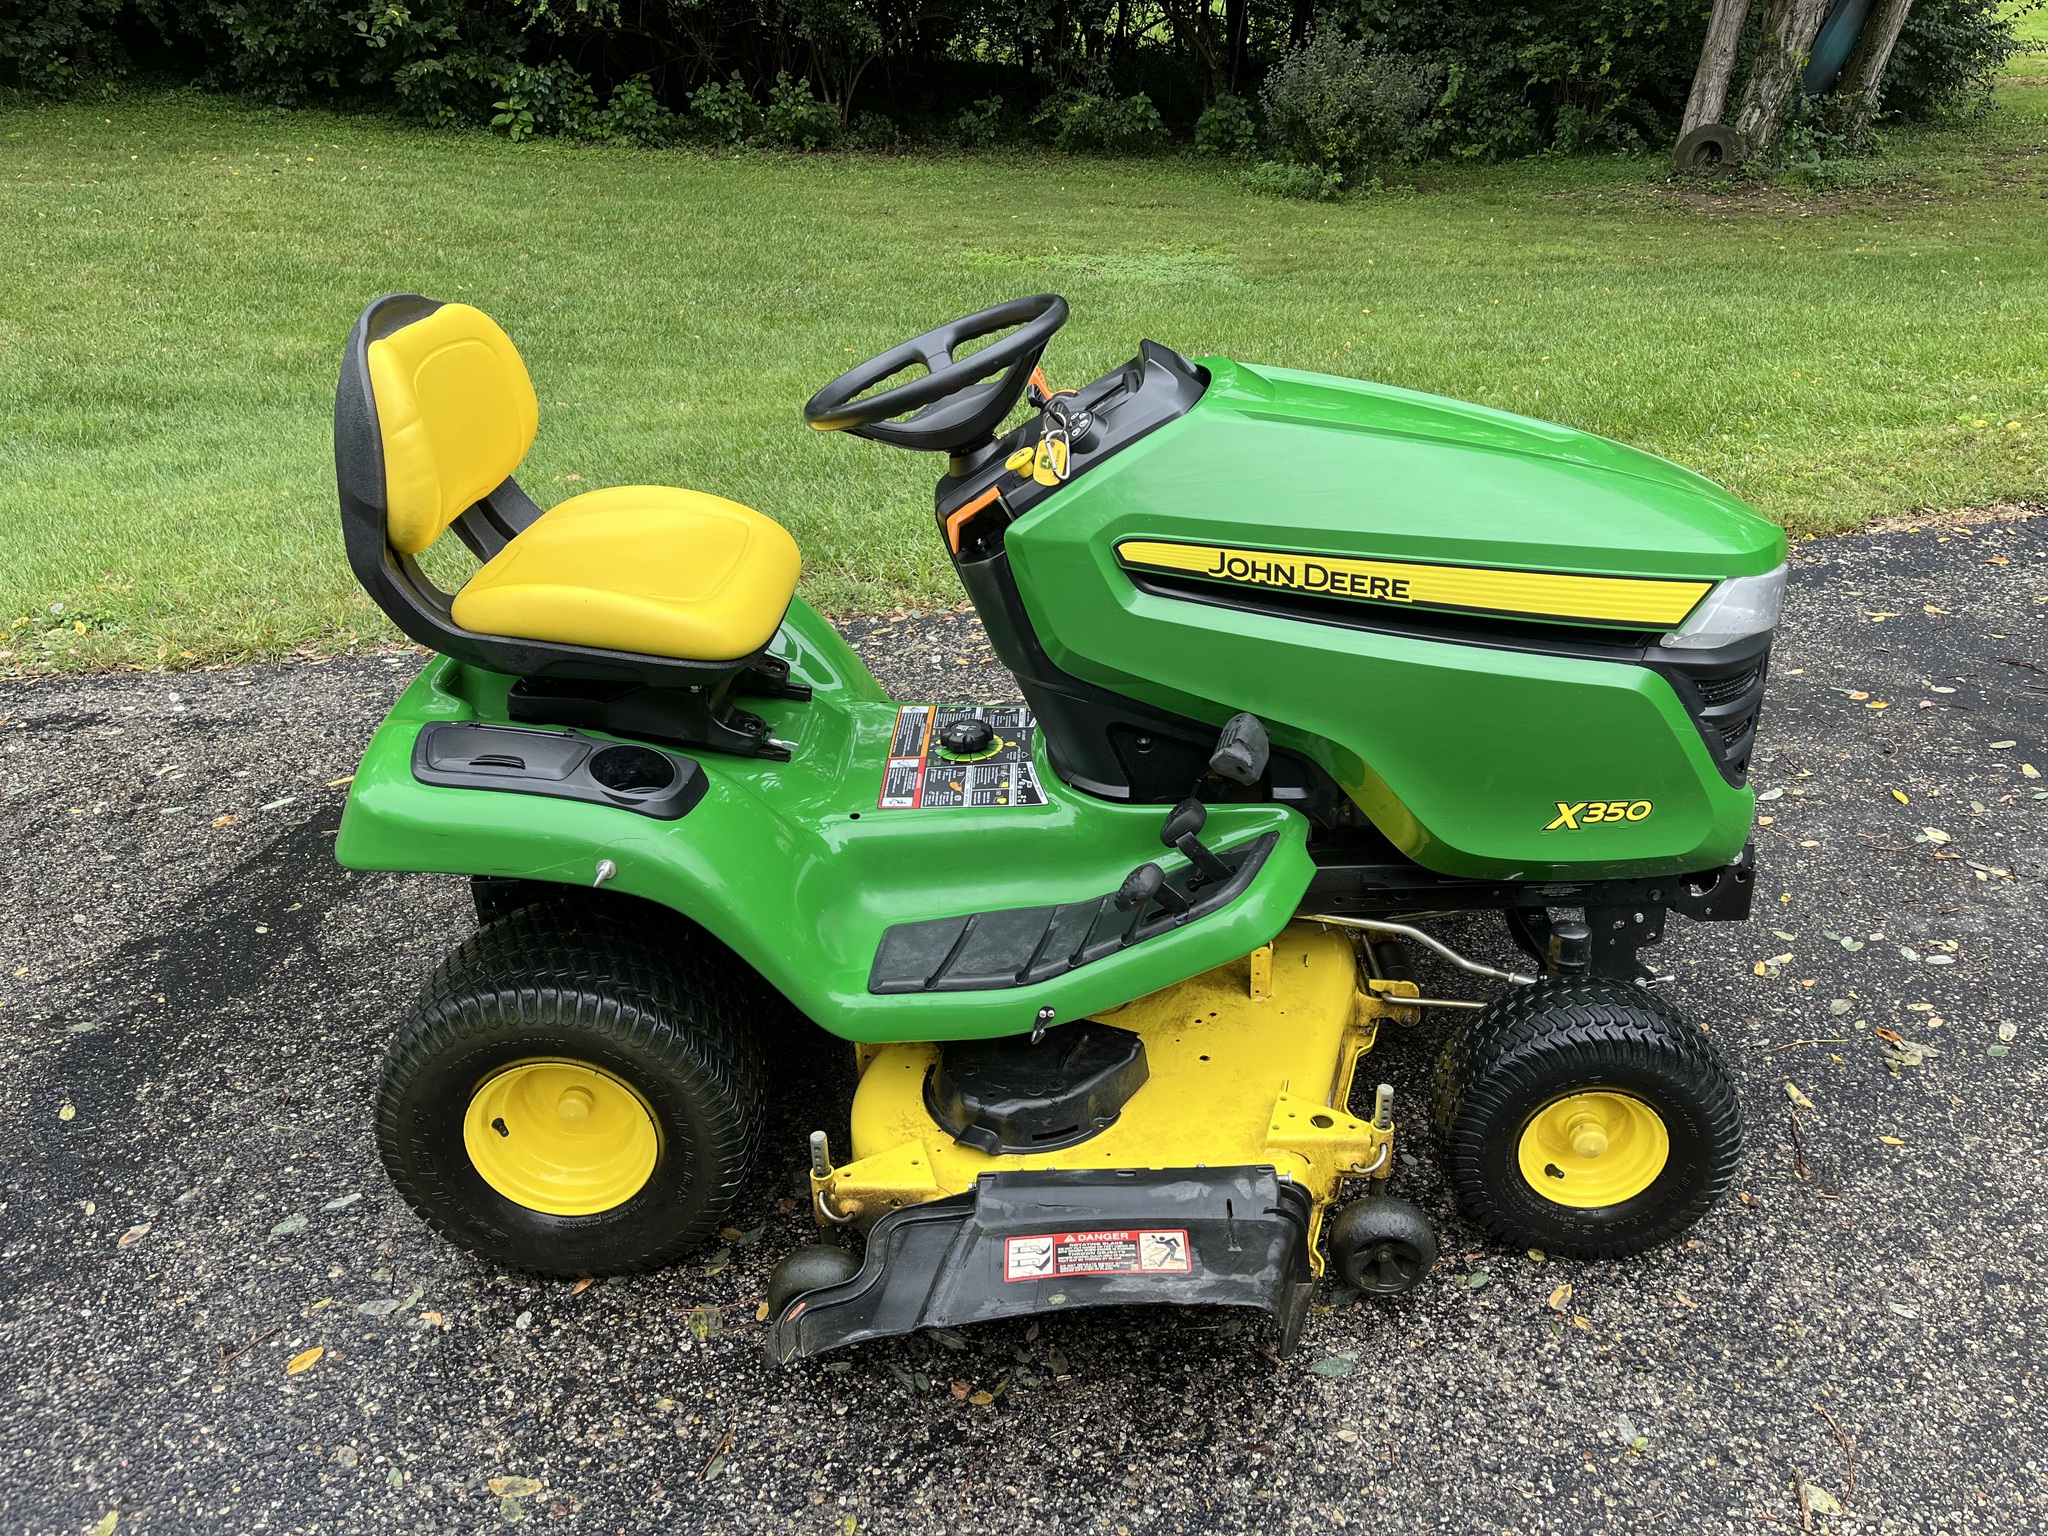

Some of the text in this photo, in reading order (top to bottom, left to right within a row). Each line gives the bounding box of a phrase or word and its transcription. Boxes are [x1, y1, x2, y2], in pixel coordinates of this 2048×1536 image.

[1208, 551, 1411, 600] JOHN DEERE
[1541, 800, 1653, 831] X350
[1078, 1232, 1129, 1242] DANGER
